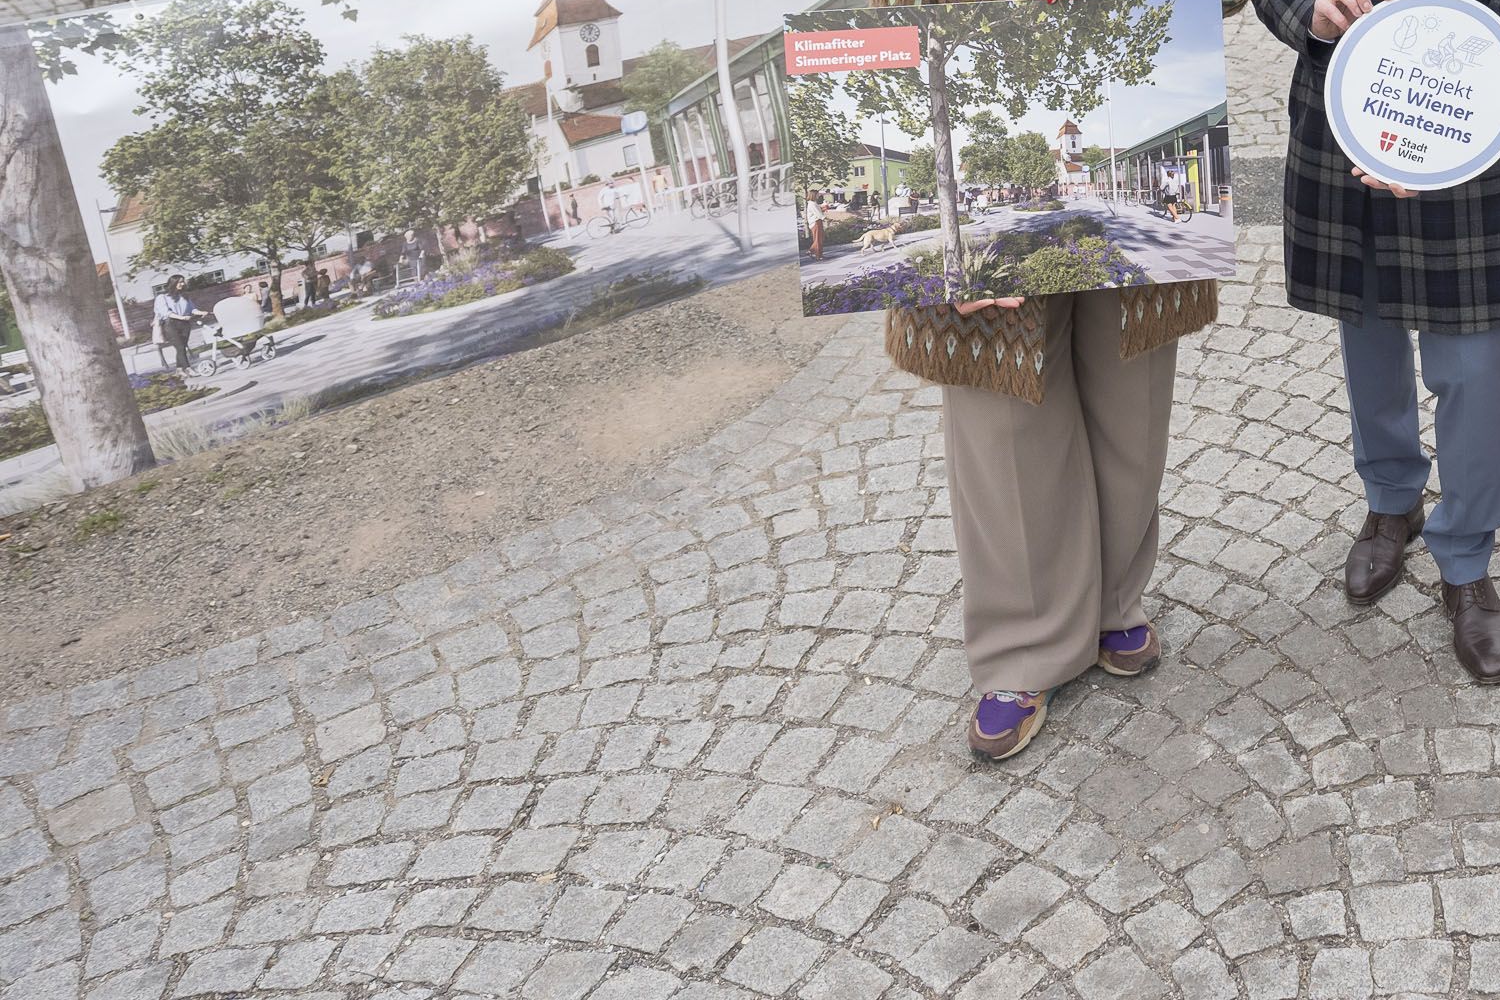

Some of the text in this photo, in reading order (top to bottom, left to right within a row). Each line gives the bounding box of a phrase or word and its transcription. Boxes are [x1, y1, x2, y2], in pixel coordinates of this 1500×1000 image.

[794, 38, 865, 51] Klimafitter
[795, 50, 911, 67] Simmeringer Platz
[1377, 57, 1473, 100] Ein Projekt
[1370, 79, 1474, 121] des Wiener
[1362, 96, 1473, 144] Klimateams
[1400, 137, 1428, 153] Stadt
[1398, 148, 1424, 163] Wien
